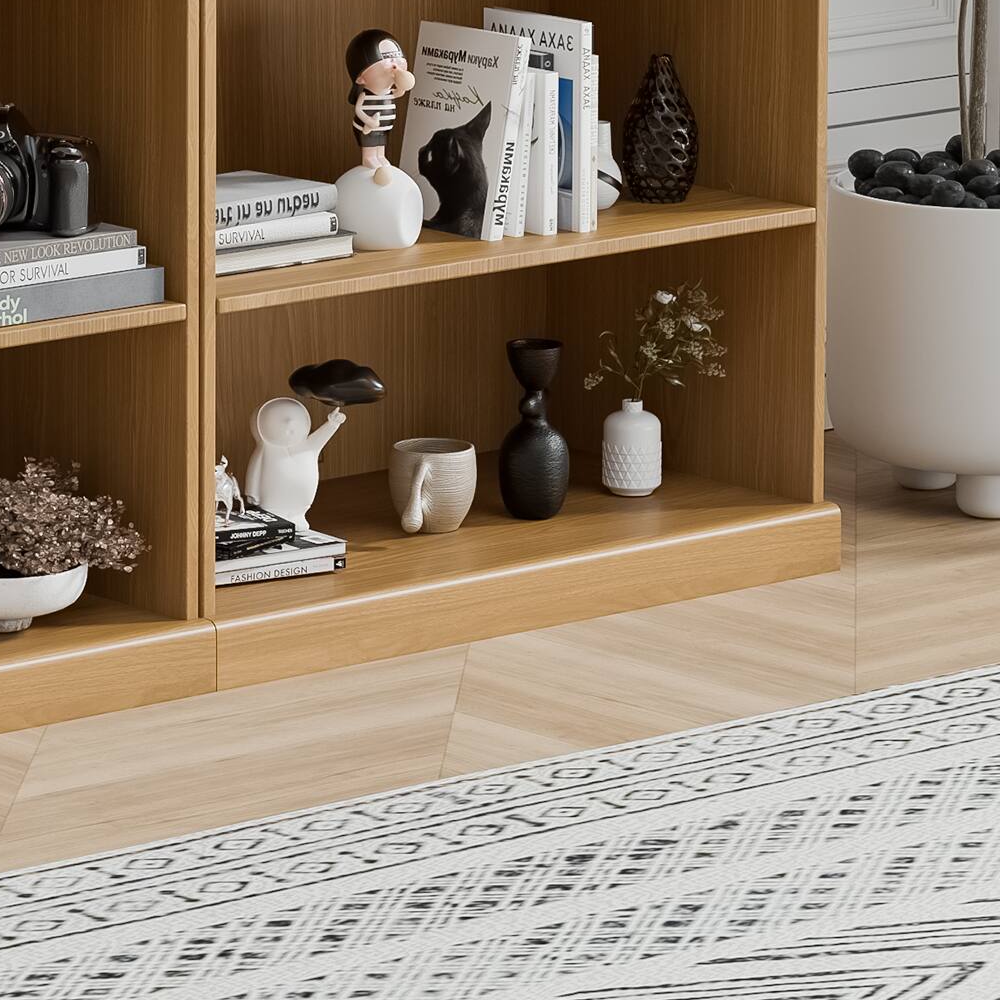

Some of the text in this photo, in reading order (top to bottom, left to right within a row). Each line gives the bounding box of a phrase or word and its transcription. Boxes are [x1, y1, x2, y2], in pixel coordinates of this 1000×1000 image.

[218, 228, 265, 246] SURVIVAL
[4, 249, 28, 264] NEW
[31, 246, 62, 260] LOOK
[63, 233, 131, 256] REVOLUTION
[19, 262, 69, 281] SURVIVAL
[230, 529, 267, 540] JOHNNY DEPP
[230, 566, 308, 582] FASHION DESIGN
